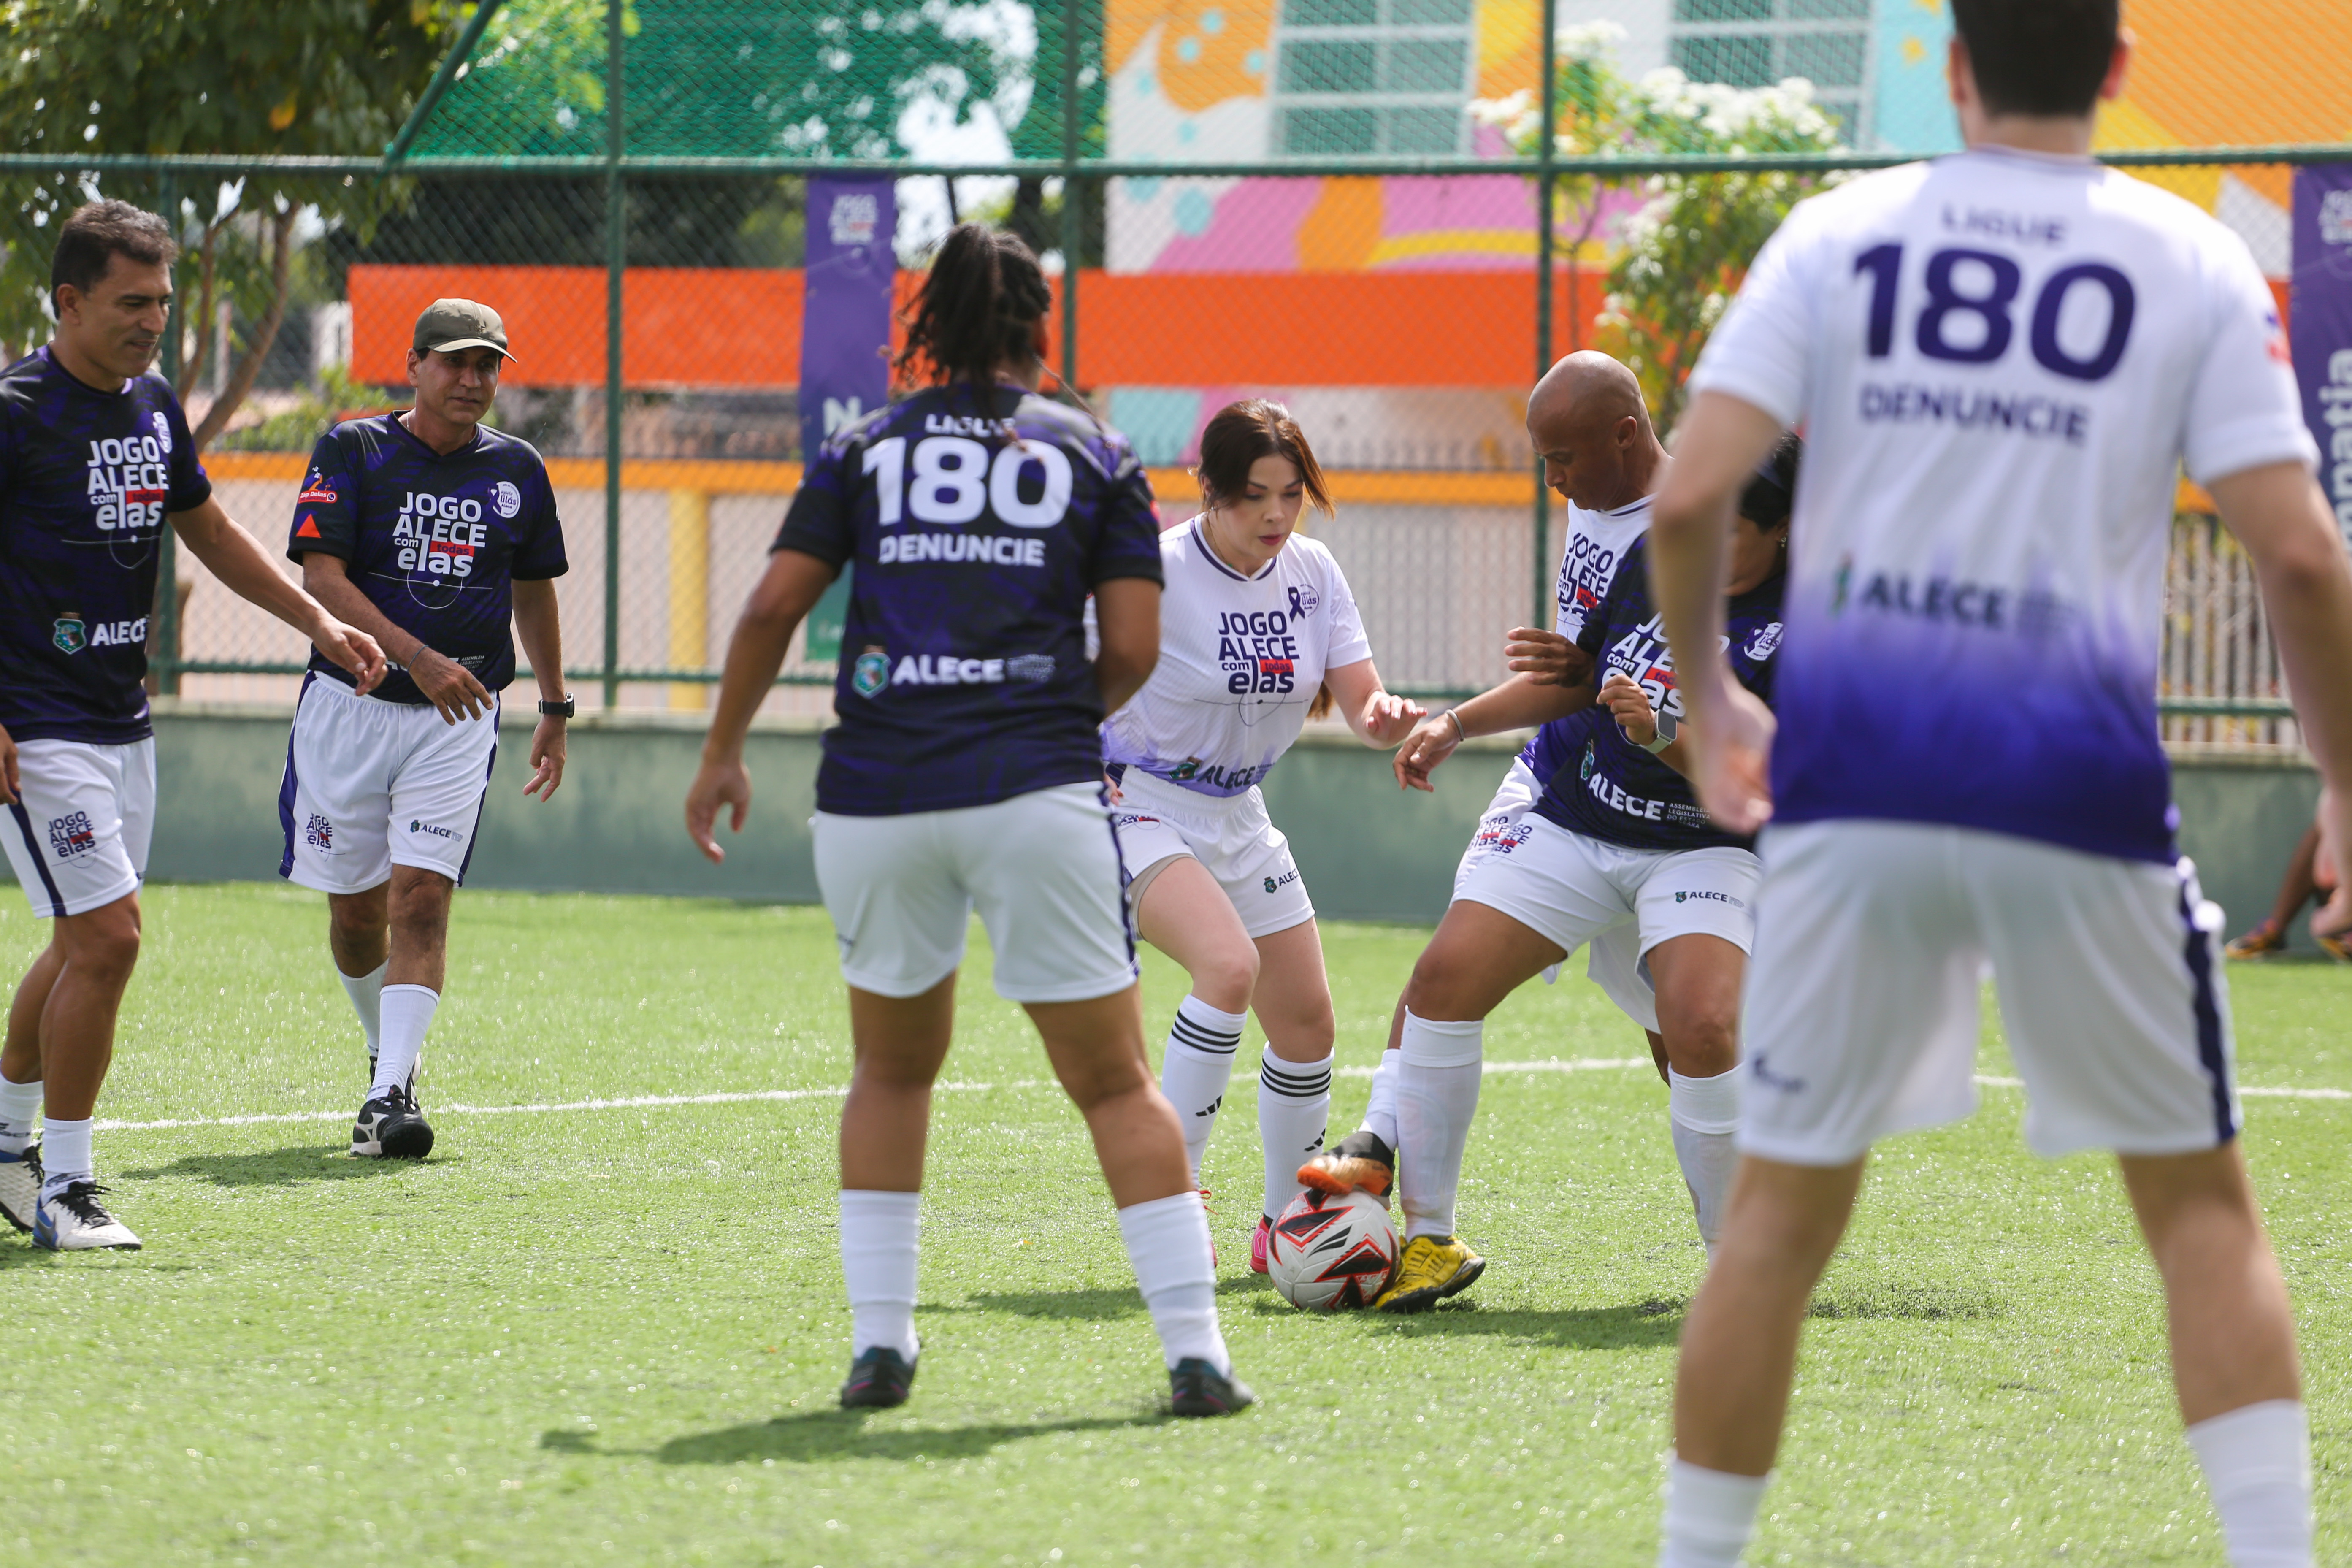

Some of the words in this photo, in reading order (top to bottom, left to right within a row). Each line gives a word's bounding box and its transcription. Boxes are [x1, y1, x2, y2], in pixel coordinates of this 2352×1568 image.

[1942, 206, 2068, 243] LIGUE
[1851, 244, 2136, 383] 180
[1858, 382, 2094, 447] DENUNCIE
[87, 436, 160, 467] JOGO
[87, 463, 169, 495] ALECE
[862, 436, 1073, 528] 180
[90, 494, 117, 505] com
[399, 491, 482, 522] JOGO
[96, 498, 164, 530] elas
[392, 514, 487, 547] ALECE
[394, 537, 419, 547] com
[398, 544, 474, 577] elas
[437, 543, 470, 555] todas
[878, 533, 1045, 567] DENUNCIE
[1568, 532, 1613, 574] JOGO
[1218, 611, 1287, 636] JOGO
[1218, 636, 1300, 661] ALECE
[892, 655, 1005, 685] ALECE
[1222, 662, 1250, 671] com
[1265, 661, 1291, 670] todas
[1606, 653, 1635, 672] com
[1228, 668, 1294, 694] elas
[1196, 757, 1256, 790] ALECE
[1589, 772, 1665, 821] ALECE
[48, 810, 86, 832] JOGO
[1668, 808, 1711, 819] LEGISLATIVA
[50, 820, 94, 844] ALECE
[307, 833, 331, 849] elas
[421, 824, 452, 838] ALECE
[57, 838, 95, 858] elas
[1689, 891, 1728, 902] ALECE
